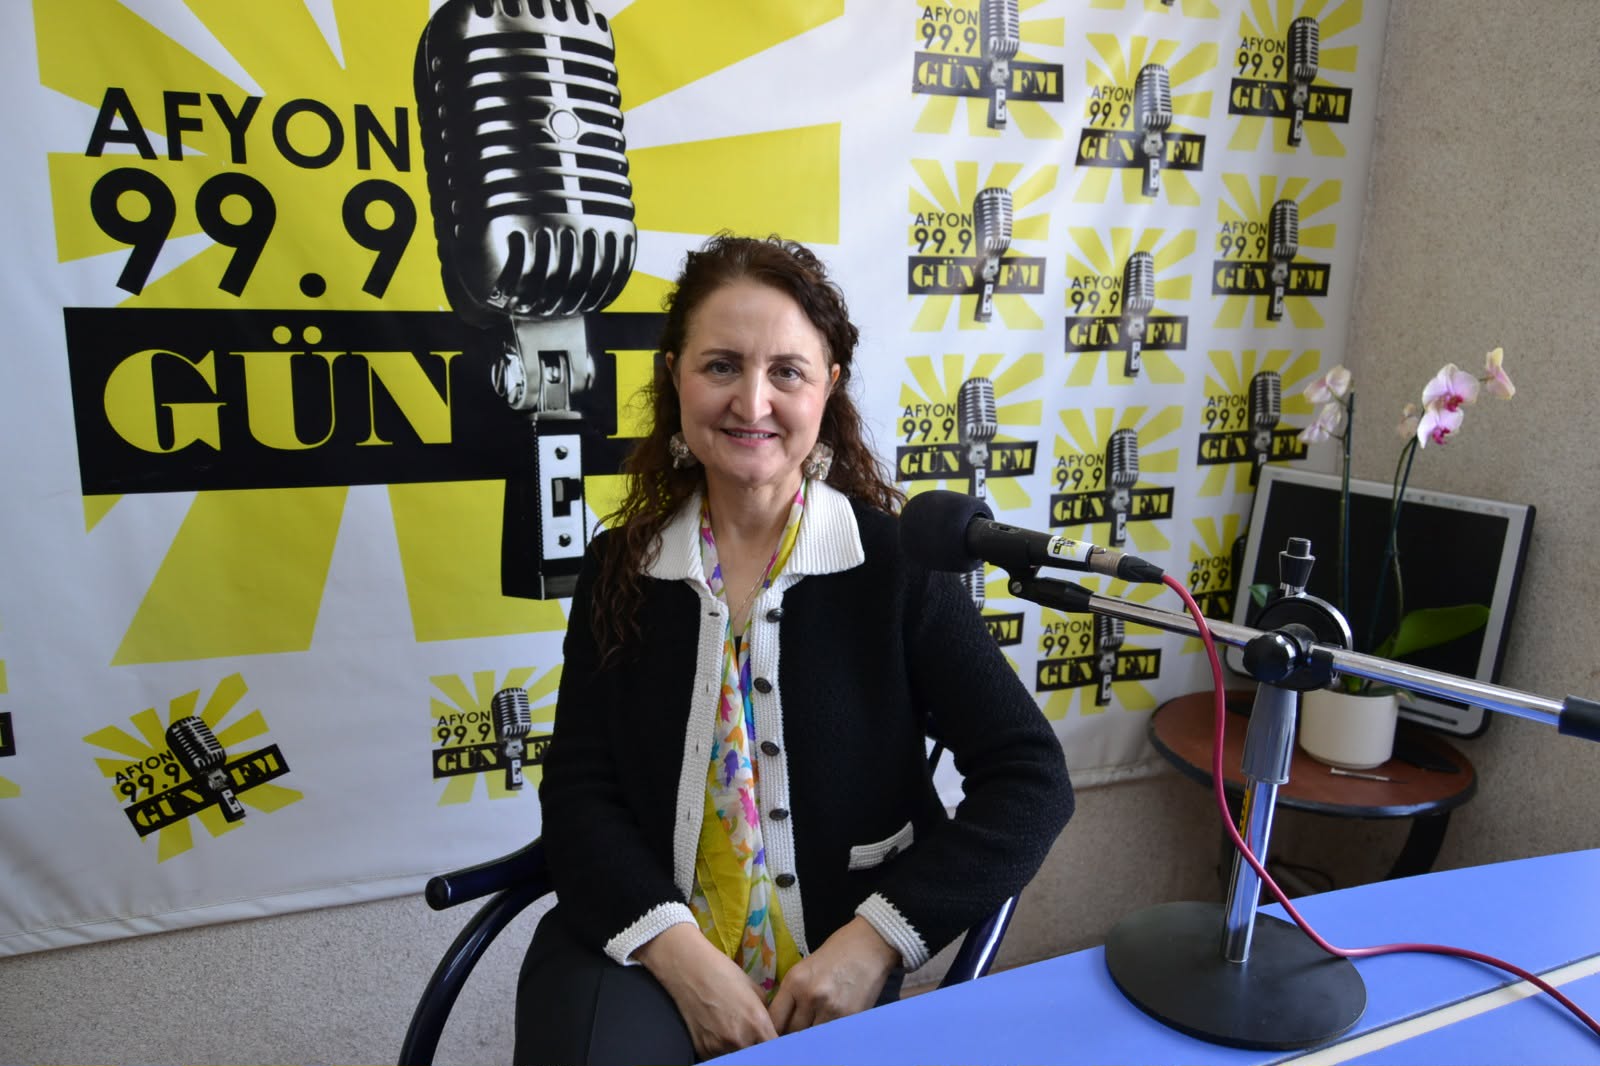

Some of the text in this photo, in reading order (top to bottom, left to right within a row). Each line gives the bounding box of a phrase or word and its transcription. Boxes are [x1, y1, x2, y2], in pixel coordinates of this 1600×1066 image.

[922, 6, 979, 26] AFYON
[921, 23, 977, 53] 99.9
[1240, 37, 1286, 53] AFYON
[917, 58, 1058, 95] GÜN FM
[1238, 52, 1285, 78] 99.9
[1091, 85, 1133, 102] AFYON
[1232, 83, 1346, 116] GÜN FM
[1089, 101, 1131, 127] 99.9
[85, 87, 411, 172] AFYON
[1080, 134, 1201, 164] GÜN FM
[914, 212, 972, 228] AFYON
[1221, 221, 1268, 235] AFYON
[90, 167, 417, 299] 99.9
[914, 228, 972, 253] 99.9
[1220, 236, 1266, 258] 99.9
[912, 259, 1040, 287] GÜN FM
[1071, 275, 1122, 290] AFYON
[1071, 291, 1120, 314] 99.9
[1146, 323, 1182, 344] FM
[104, 326, 463, 454] GÜN
[1207, 394, 1247, 407] AFYON
[903, 404, 956, 417] AFYON
[1205, 408, 1246, 430] 99.9
[902, 418, 954, 443] 99.9
[900, 446, 1032, 475] GÜN FM
[1057, 454, 1105, 468] AFYON
[1056, 467, 1103, 491] 99.9
[1053, 494, 1169, 522] GÜN FM
[1192, 556, 1230, 571] AFYON
[1190, 568, 1229, 593] 99.9
[1044, 621, 1092, 635] AFYON
[1043, 633, 1091, 657] 99.9
[1039, 655, 1157, 686] GÜN FM
[437, 710, 491, 727] AFYON
[437, 722, 491, 747] 99.9
[115, 749, 174, 785] AFYON
[437, 740, 551, 772] GÜN F
[120, 763, 180, 802] 99.9
